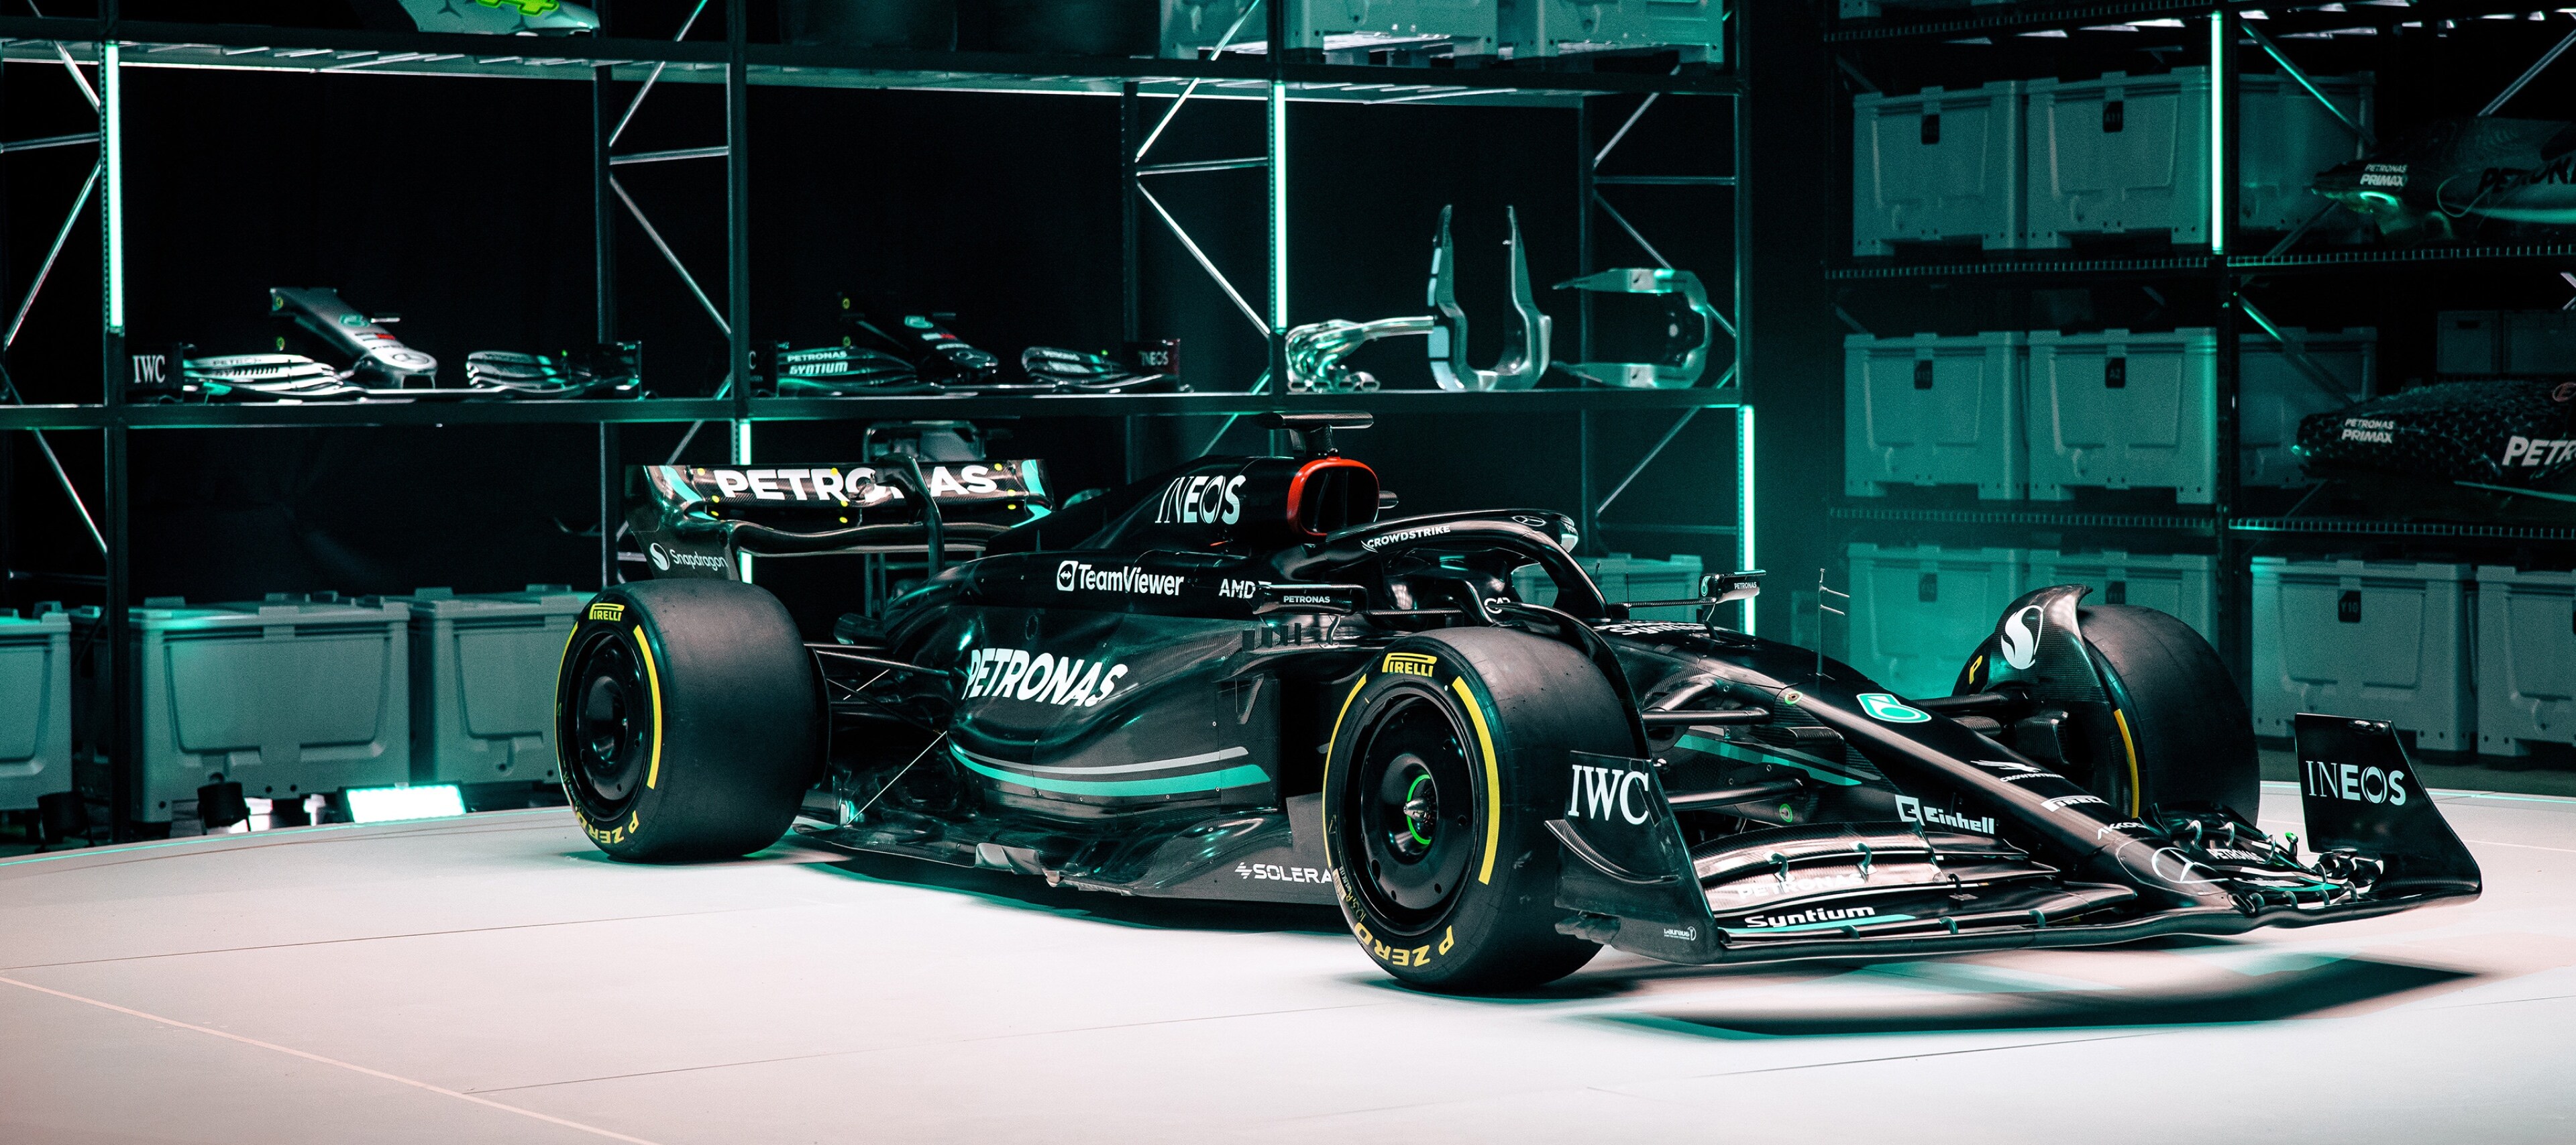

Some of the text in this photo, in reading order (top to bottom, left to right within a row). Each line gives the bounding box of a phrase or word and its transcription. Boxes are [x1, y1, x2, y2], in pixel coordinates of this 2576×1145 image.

[2365, 164, 2408, 173] PETRONAS
[2360, 174, 2406, 186] PRIMAX
[787, 350, 847, 362] PETRONAS
[133, 355, 166, 384] IWC
[2345, 418, 2394, 430] PETRONAS
[2341, 429, 2393, 443] PRIMAX
[2502, 435, 2576, 467] PETR
[1155, 474, 1246, 525] INEOS
[1366, 525, 1451, 548] CROWDSTRIKE
[669, 549, 729, 571] Snapdragon
[1078, 564, 1185, 596] TeamViewer
[1218, 578, 1255, 599] AMD
[1734, 582, 1757, 590] PETRONAS
[1283, 594, 1330, 604] PETRONAS
[589, 603, 625, 622] PIRELLI
[1382, 652, 1437, 677] PIRELLI
[961, 648, 1128, 707] PETRONAS
[1568, 764, 1649, 825] IWC
[2306, 761, 2406, 806] INEOS
[576, 810, 639, 844] P ZERO
[1923, 806, 1994, 834] Einhell
[2206, 849, 2267, 863] PETRONAS
[1252, 863, 1334, 884] SOLERA
[1737, 871, 1866, 899] PETRONAS
[1744, 906, 1876, 928] Syntium
[1354, 922, 1454, 967] P ZERO
